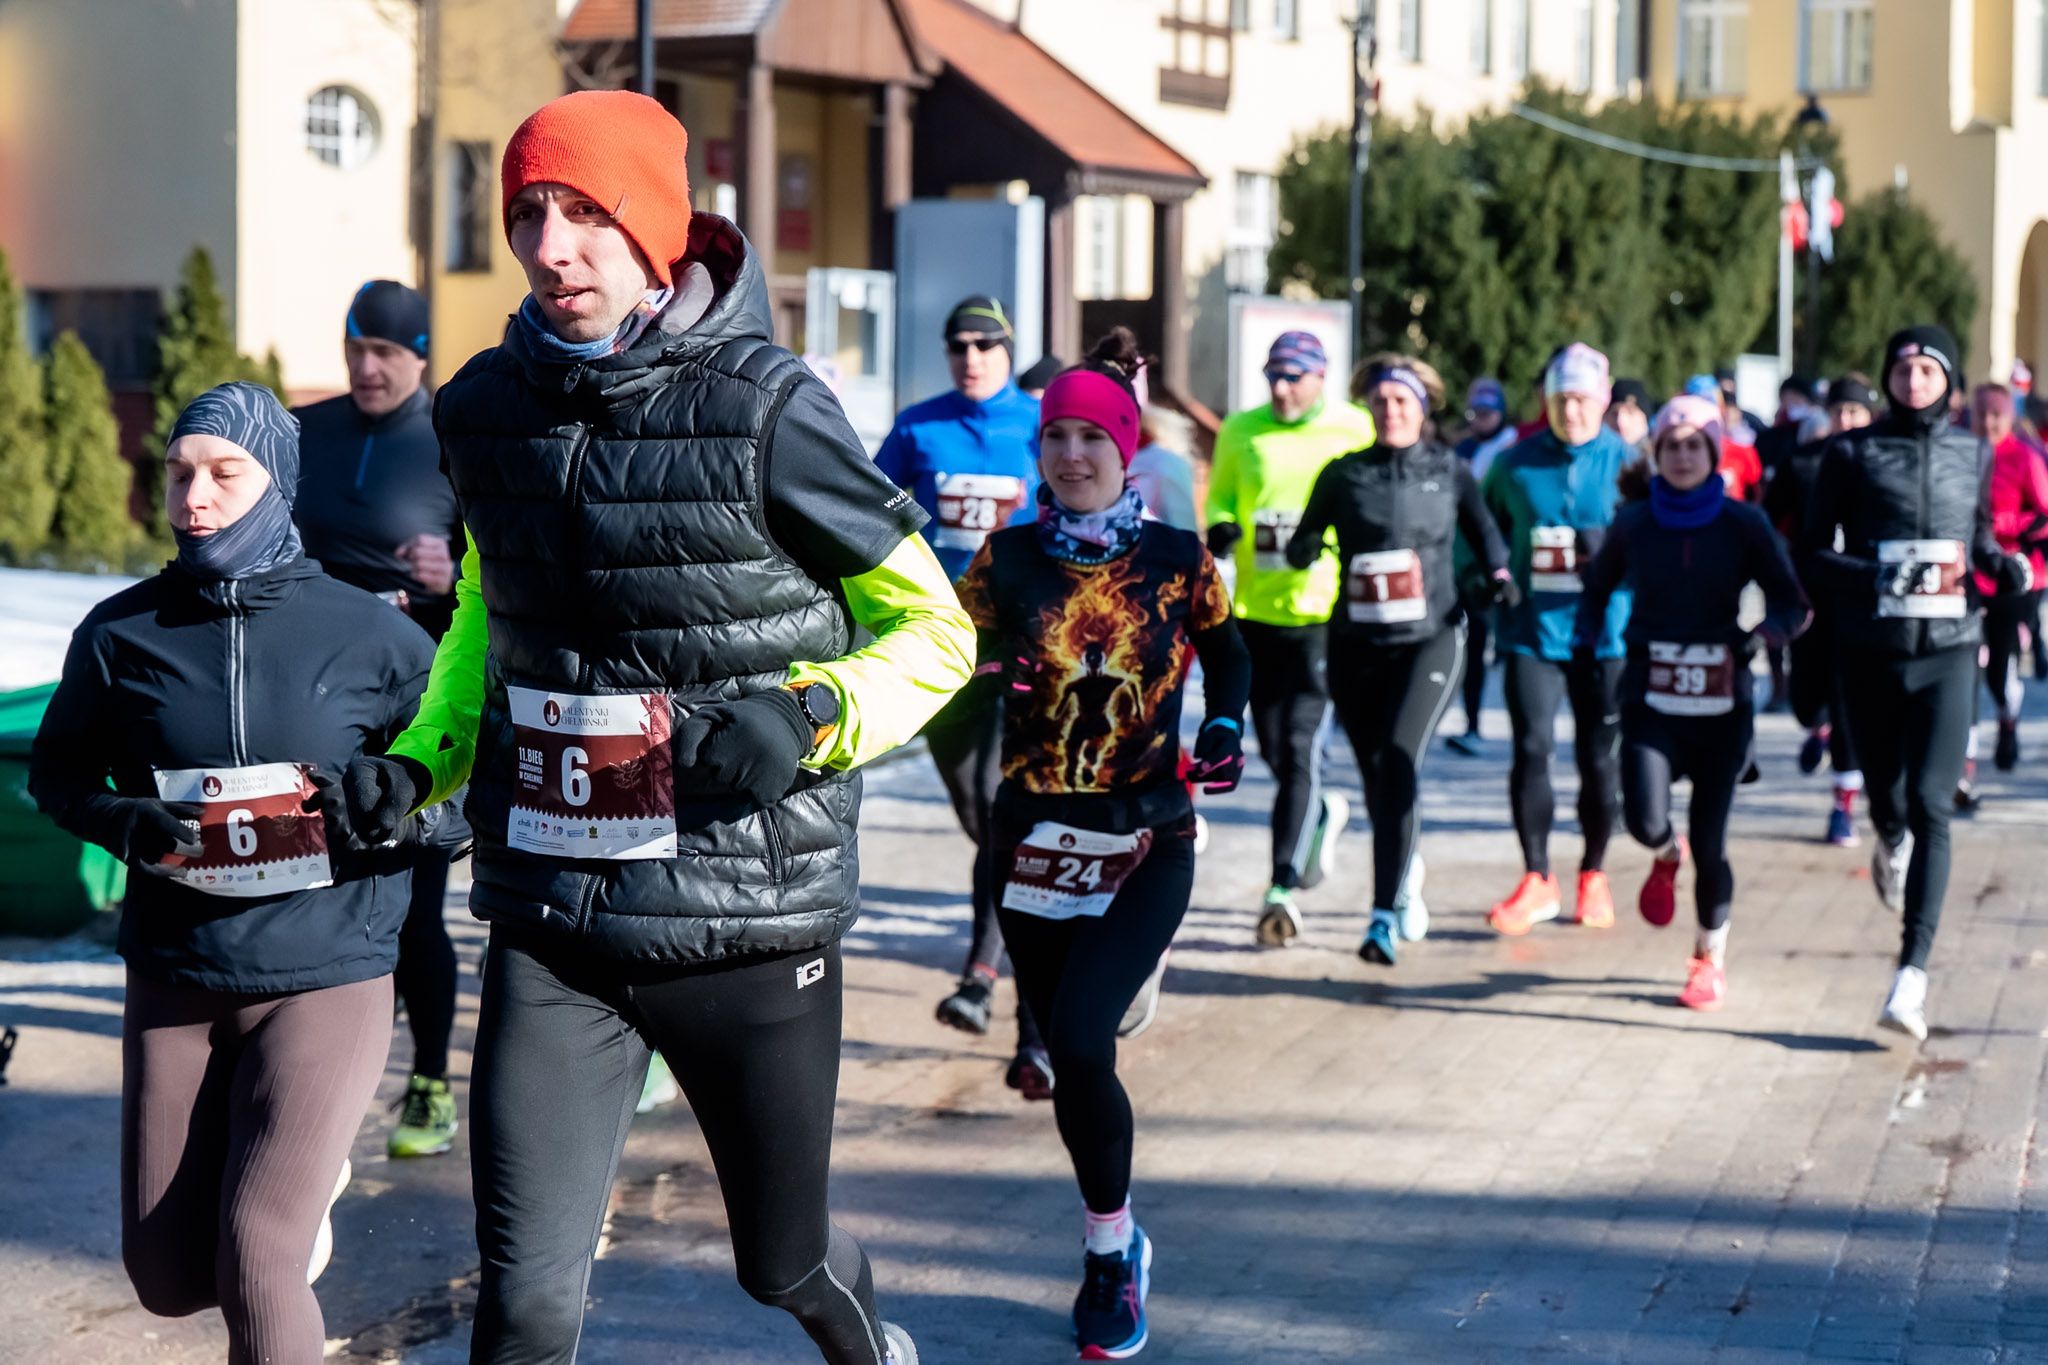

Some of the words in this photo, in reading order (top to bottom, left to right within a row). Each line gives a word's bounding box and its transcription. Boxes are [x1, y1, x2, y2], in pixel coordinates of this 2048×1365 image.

[1373, 574, 1389, 602] 1
[1674, 665, 1707, 695] 39
[518, 746, 544, 766] 11.BIEG
[561, 746, 592, 807] 6
[226, 808, 258, 857] 6
[1054, 856, 1104, 891] 24
